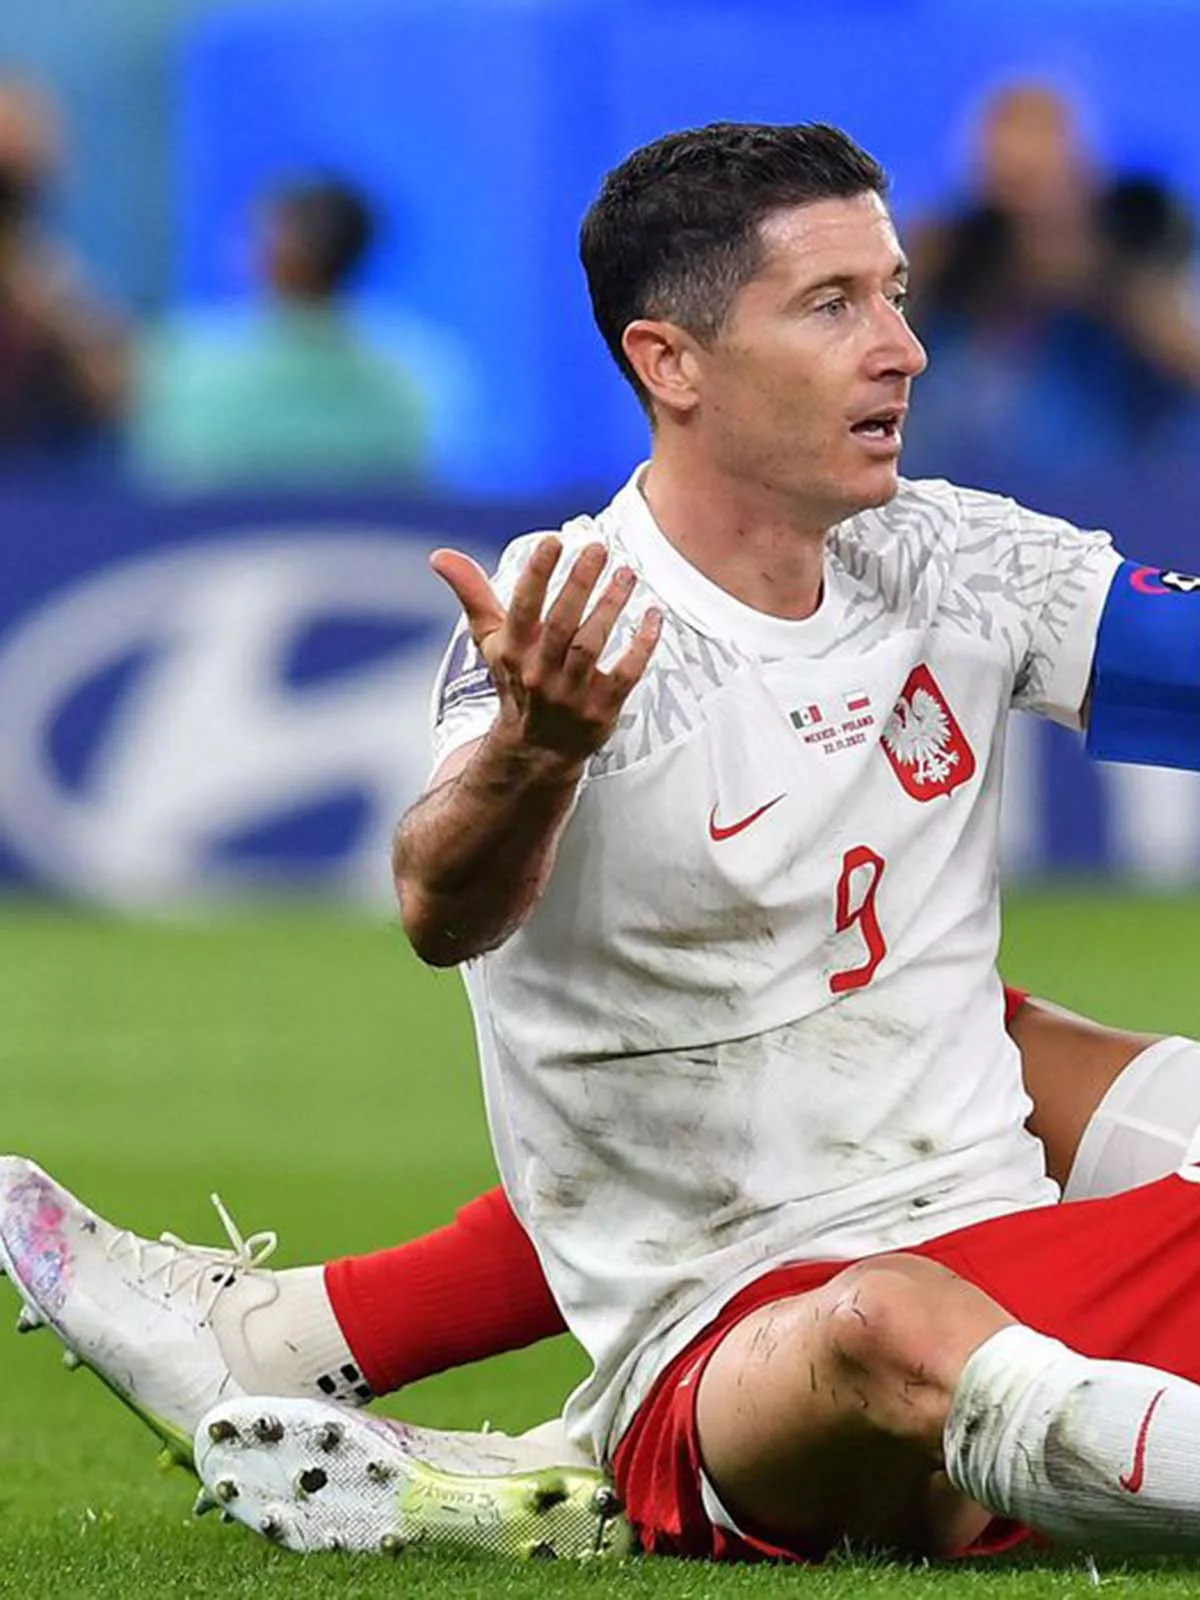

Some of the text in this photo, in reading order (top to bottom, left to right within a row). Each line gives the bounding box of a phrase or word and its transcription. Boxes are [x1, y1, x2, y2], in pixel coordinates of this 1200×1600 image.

[805, 728, 836, 743] MEXICO
[842, 715, 874, 731] POLAND
[829, 845, 887, 993] 9
